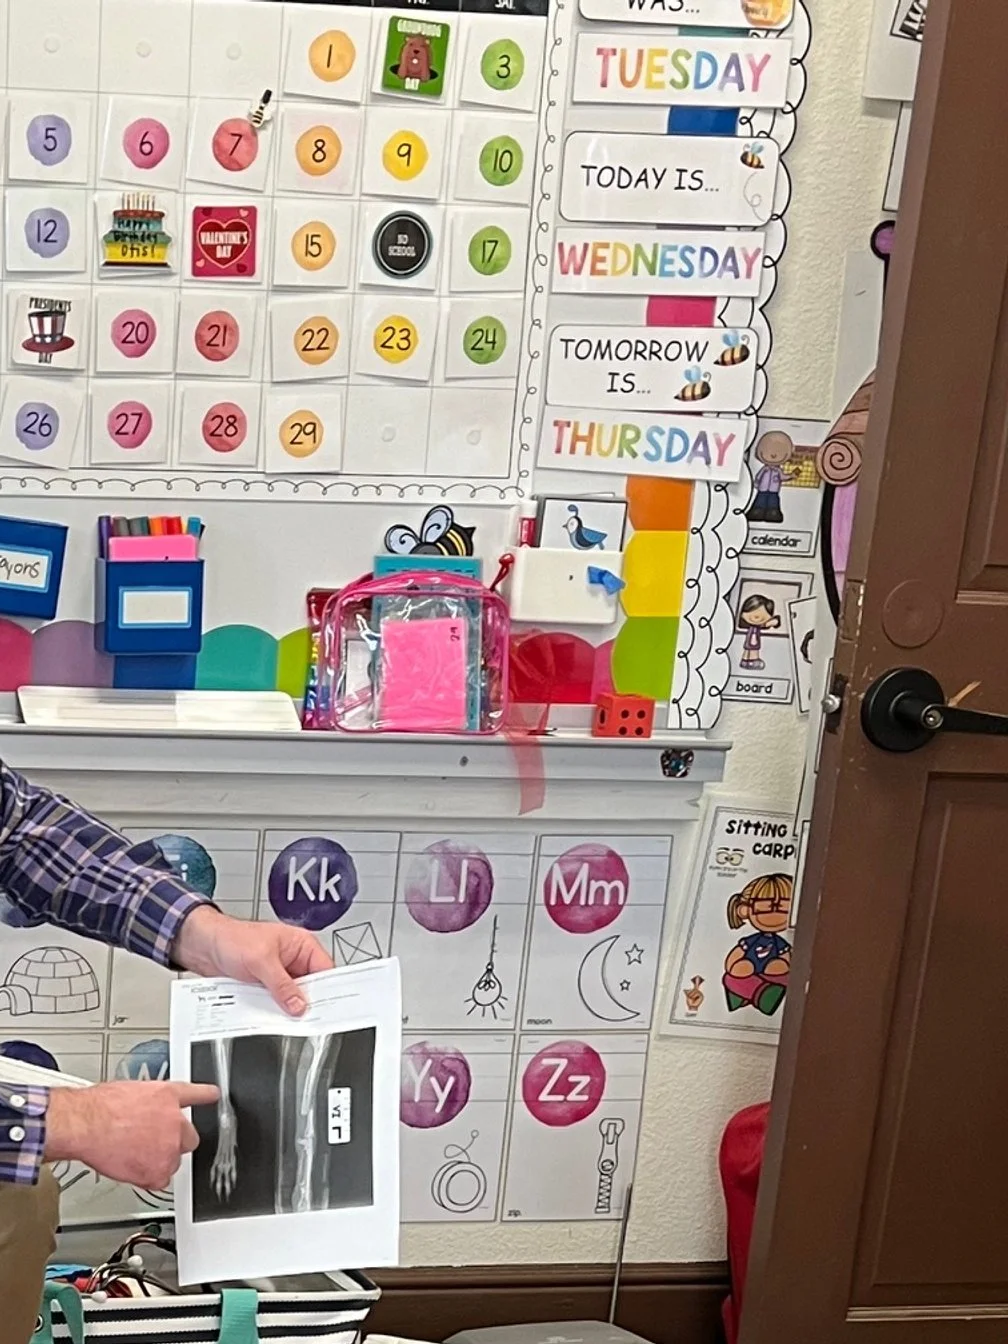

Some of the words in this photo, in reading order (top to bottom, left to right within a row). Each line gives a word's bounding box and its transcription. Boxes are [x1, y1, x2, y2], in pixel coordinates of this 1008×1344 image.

[496, 55, 511, 79] 3
[596, 47, 771, 92] TUESDAY
[43, 127, 58, 152] 5
[139, 131, 154, 157] 6
[228, 132, 243, 157] 7
[311, 138, 327, 163] 8
[397, 143, 412, 167] 9
[493, 149, 513, 174] 10
[580, 164, 667, 190] TODAY
[674, 168, 720, 192] IS...
[36, 219, 58, 243] 12
[216, 245, 232, 258] DAY
[304, 234, 322, 258] 15
[388, 246, 416, 257] SCHOOL
[481, 239, 499, 264] 17
[557, 241, 762, 279] WEDNESDAY
[121, 321, 150, 345] 20
[205, 324, 228, 347] 21
[301, 327, 330, 352] 22
[379, 326, 411, 351] 23
[470, 328, 498, 352] 24
[559, 338, 709, 363] TOMORROW
[606, 371, 652, 395] IS...
[22, 411, 52, 438] 26
[114, 412, 143, 436] 27
[208, 414, 239, 438] 28
[289, 421, 317, 445] 29
[552, 420, 736, 467] THURSDAY
[751, 533, 801, 548] calendar
[735, 680, 773, 694] board
[286, 856, 342, 903] Kk
[429, 857, 466, 903] Ll
[550, 862, 628, 907] Mm
[113, 1015, 129, 1025] jar
[527, 1018, 553, 1026] moon
[407, 1062, 456, 1113] Yy
[537, 1056, 592, 1103] Zz
